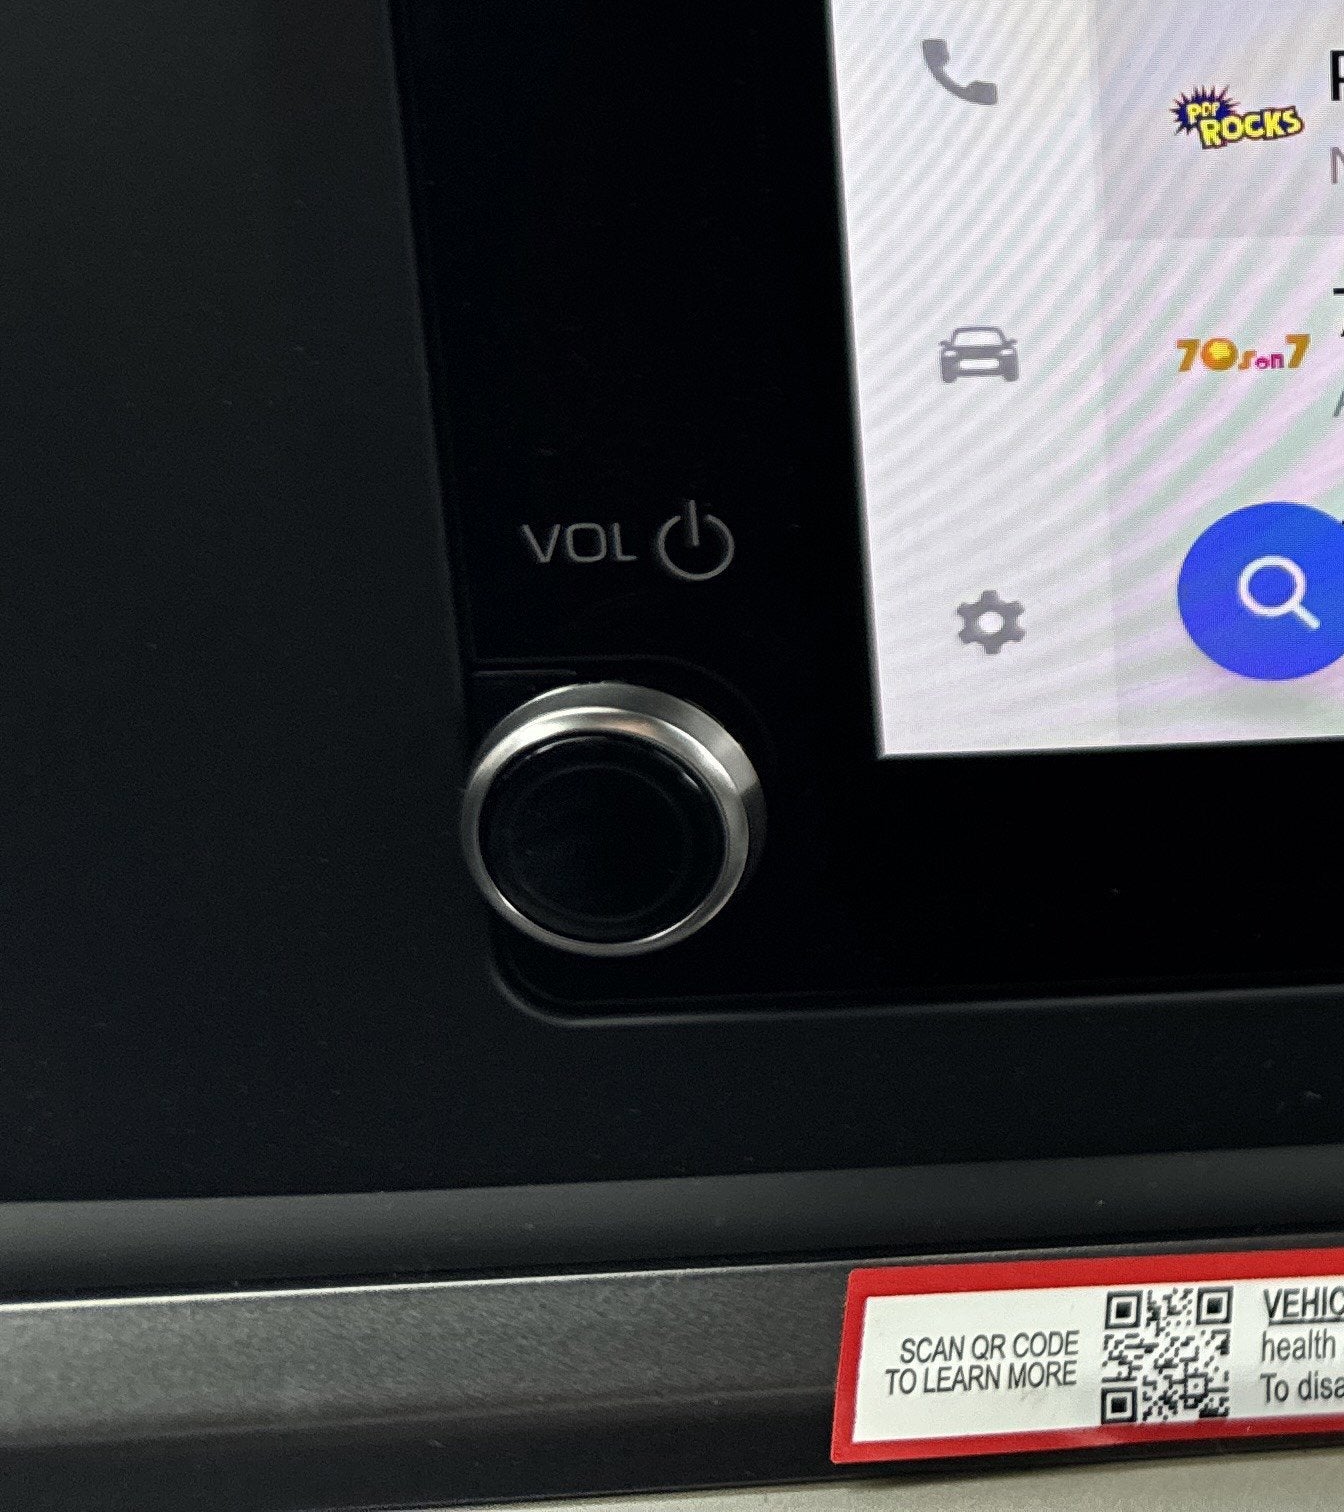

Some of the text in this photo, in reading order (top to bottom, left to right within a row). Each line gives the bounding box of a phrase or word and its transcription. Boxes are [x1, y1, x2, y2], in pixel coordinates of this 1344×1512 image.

[1200, 110, 1300, 146] ROCKS
[522, 522, 638, 563] VOL
[900, 1330, 1079, 1365] SCAN QR CODE
[1261, 1325, 1336, 1364] health
[885, 1361, 1077, 1396] TO LEARN MORE
[1261, 1370, 1291, 1403] To
